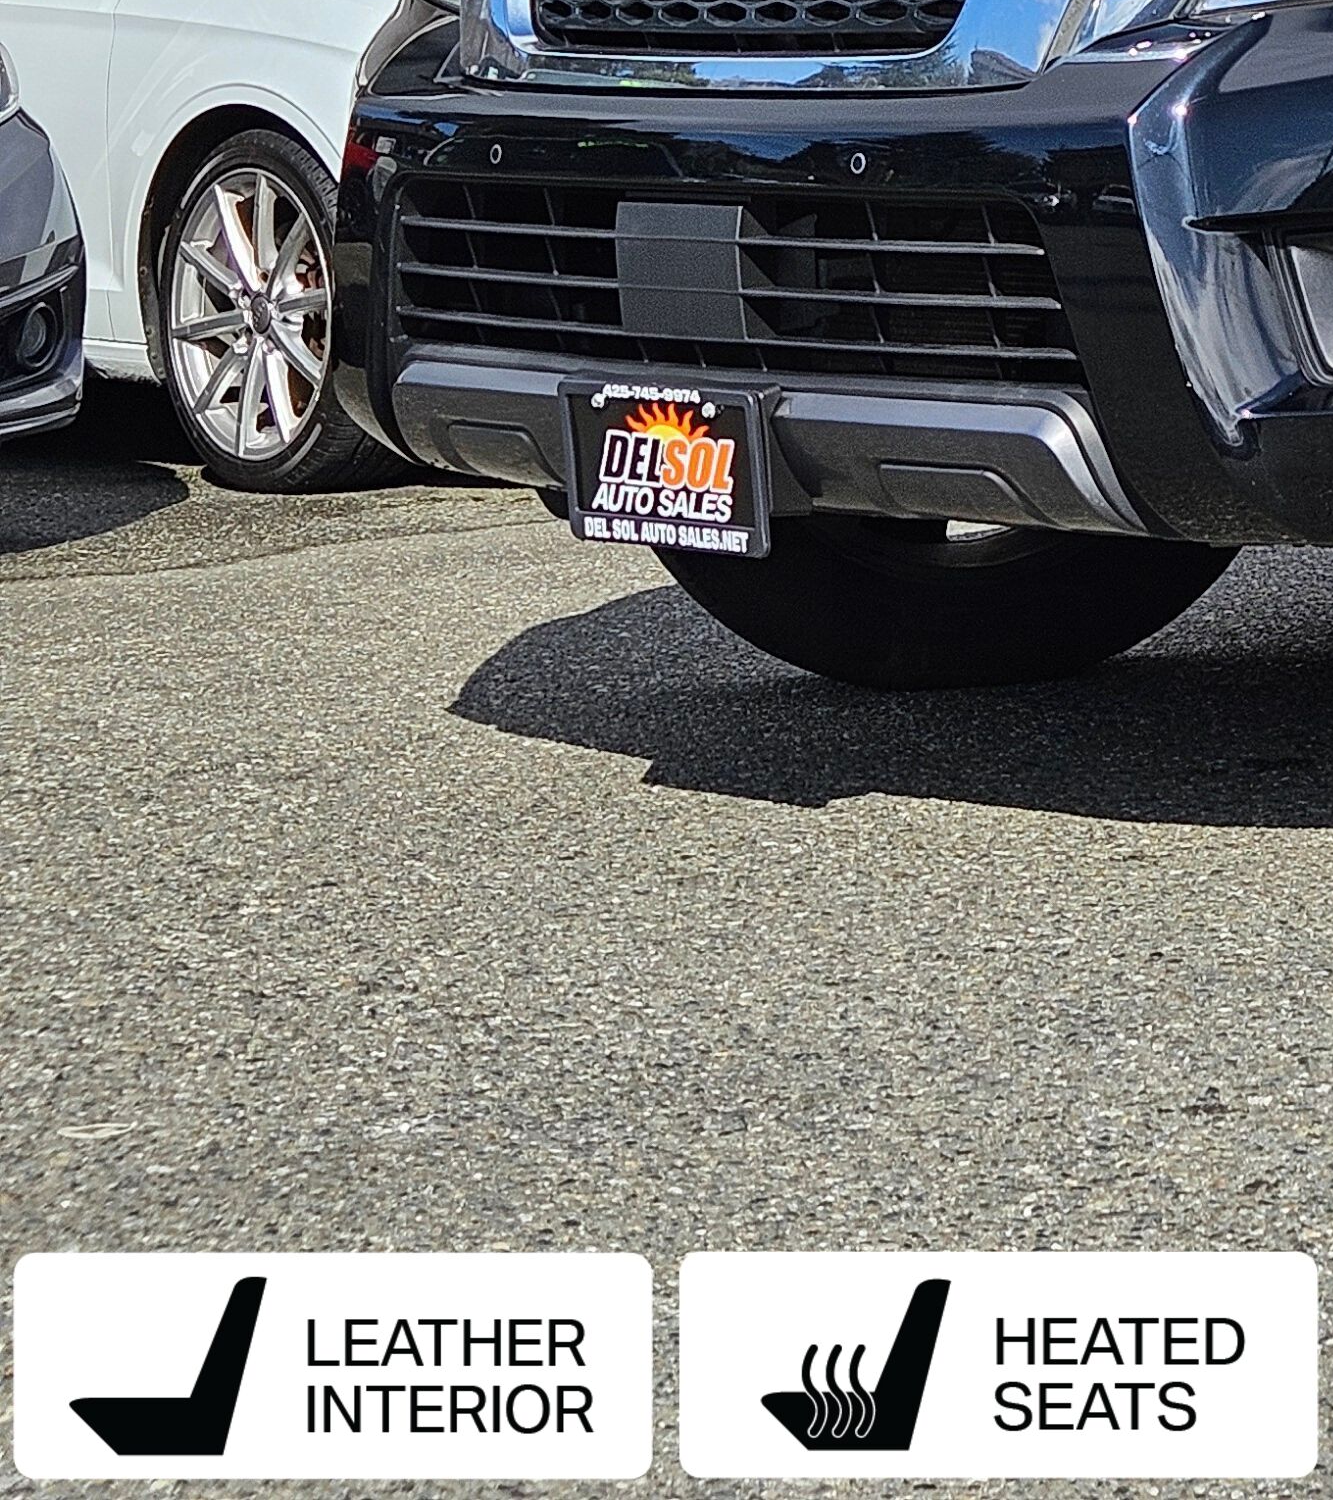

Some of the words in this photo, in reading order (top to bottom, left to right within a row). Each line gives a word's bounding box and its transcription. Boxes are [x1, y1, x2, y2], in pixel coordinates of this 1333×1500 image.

[602, 383, 701, 404] 425-745-9974
[592, 482, 655, 515] AUTO
[657, 490, 733, 523] SALES
[583, 516, 612, 539] DEL
[612, 518, 639, 542] SOL
[641, 521, 677, 546] AUTO
[678, 525, 749, 554] SALES.NET
